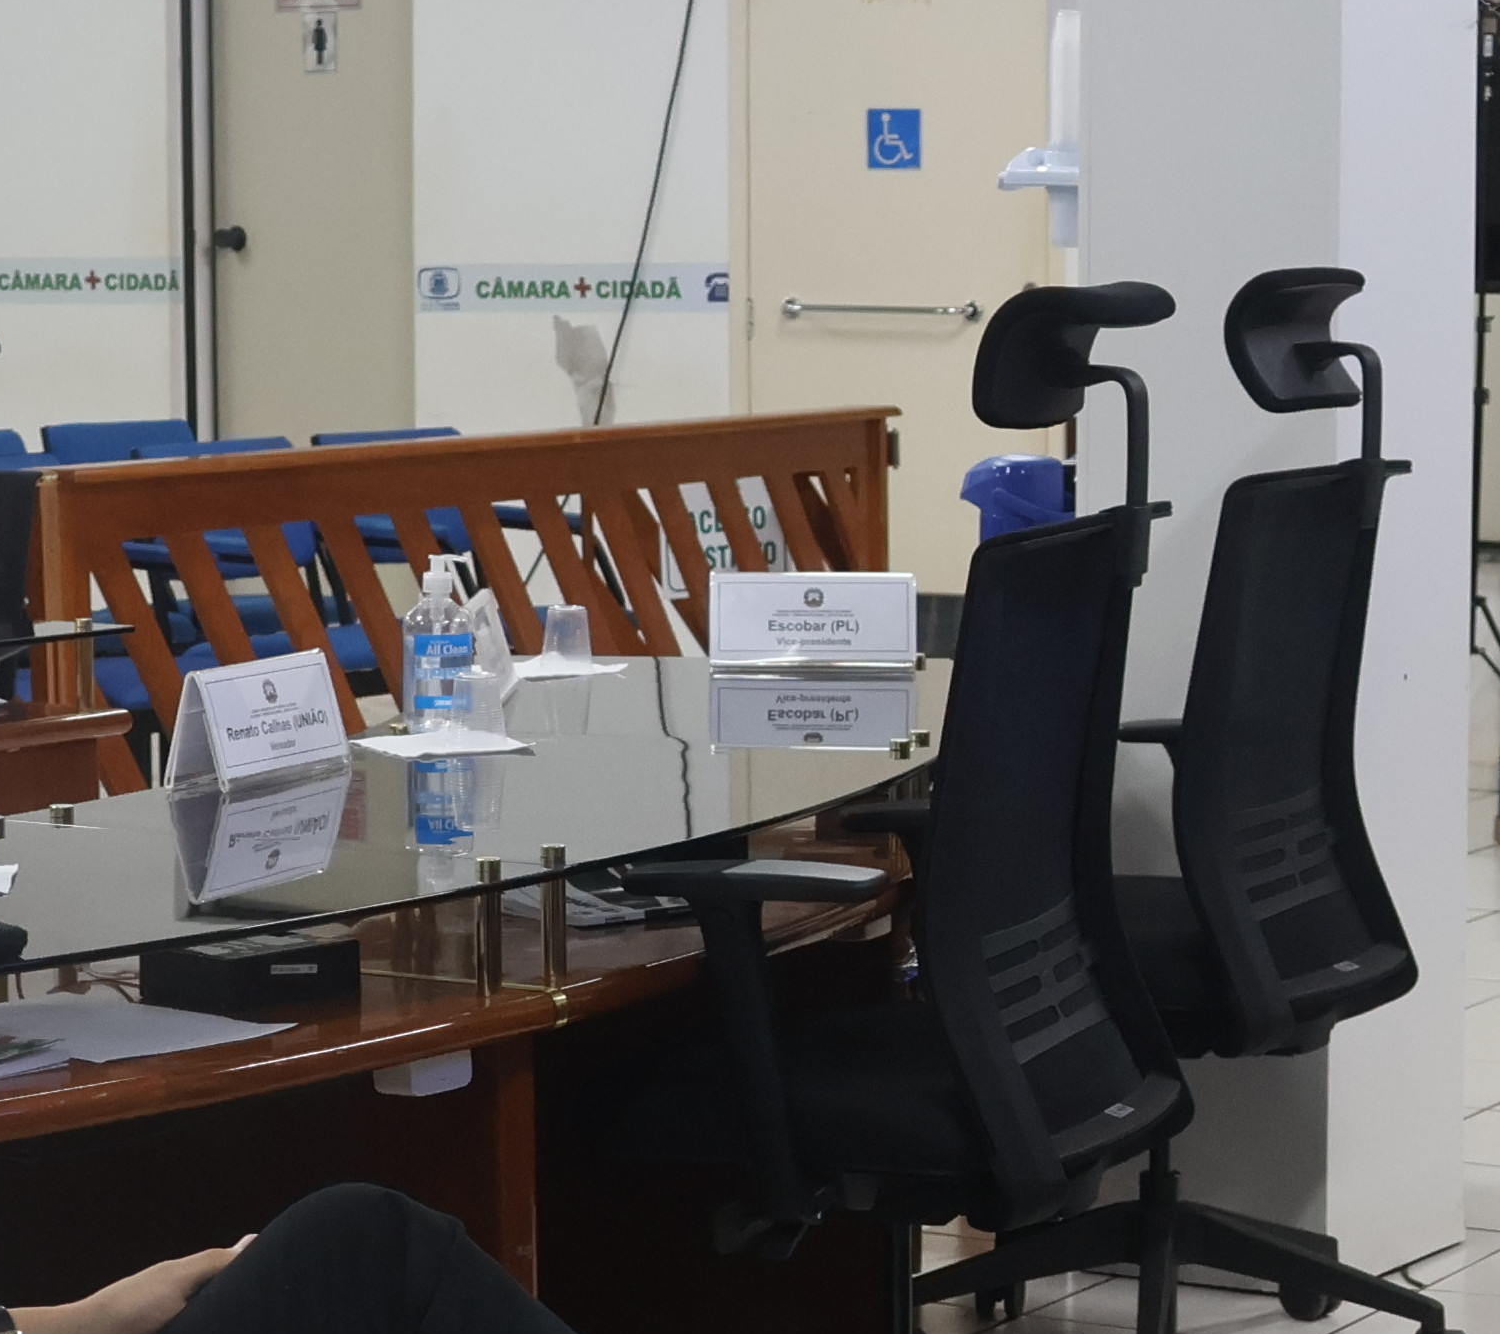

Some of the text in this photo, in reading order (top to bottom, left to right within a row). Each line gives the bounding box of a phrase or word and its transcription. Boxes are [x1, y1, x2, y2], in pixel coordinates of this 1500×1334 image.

[104, 270, 179, 291] CIDADÃ
[475, 276, 571, 299] CÂMARA
[595, 276, 682, 299] CIDADÃ
[768, 619, 860, 634] Escobar (PL)
[426, 643, 440, 655] All
[226, 726, 260, 742] Renato
[261, 719, 292, 735] Calhas
